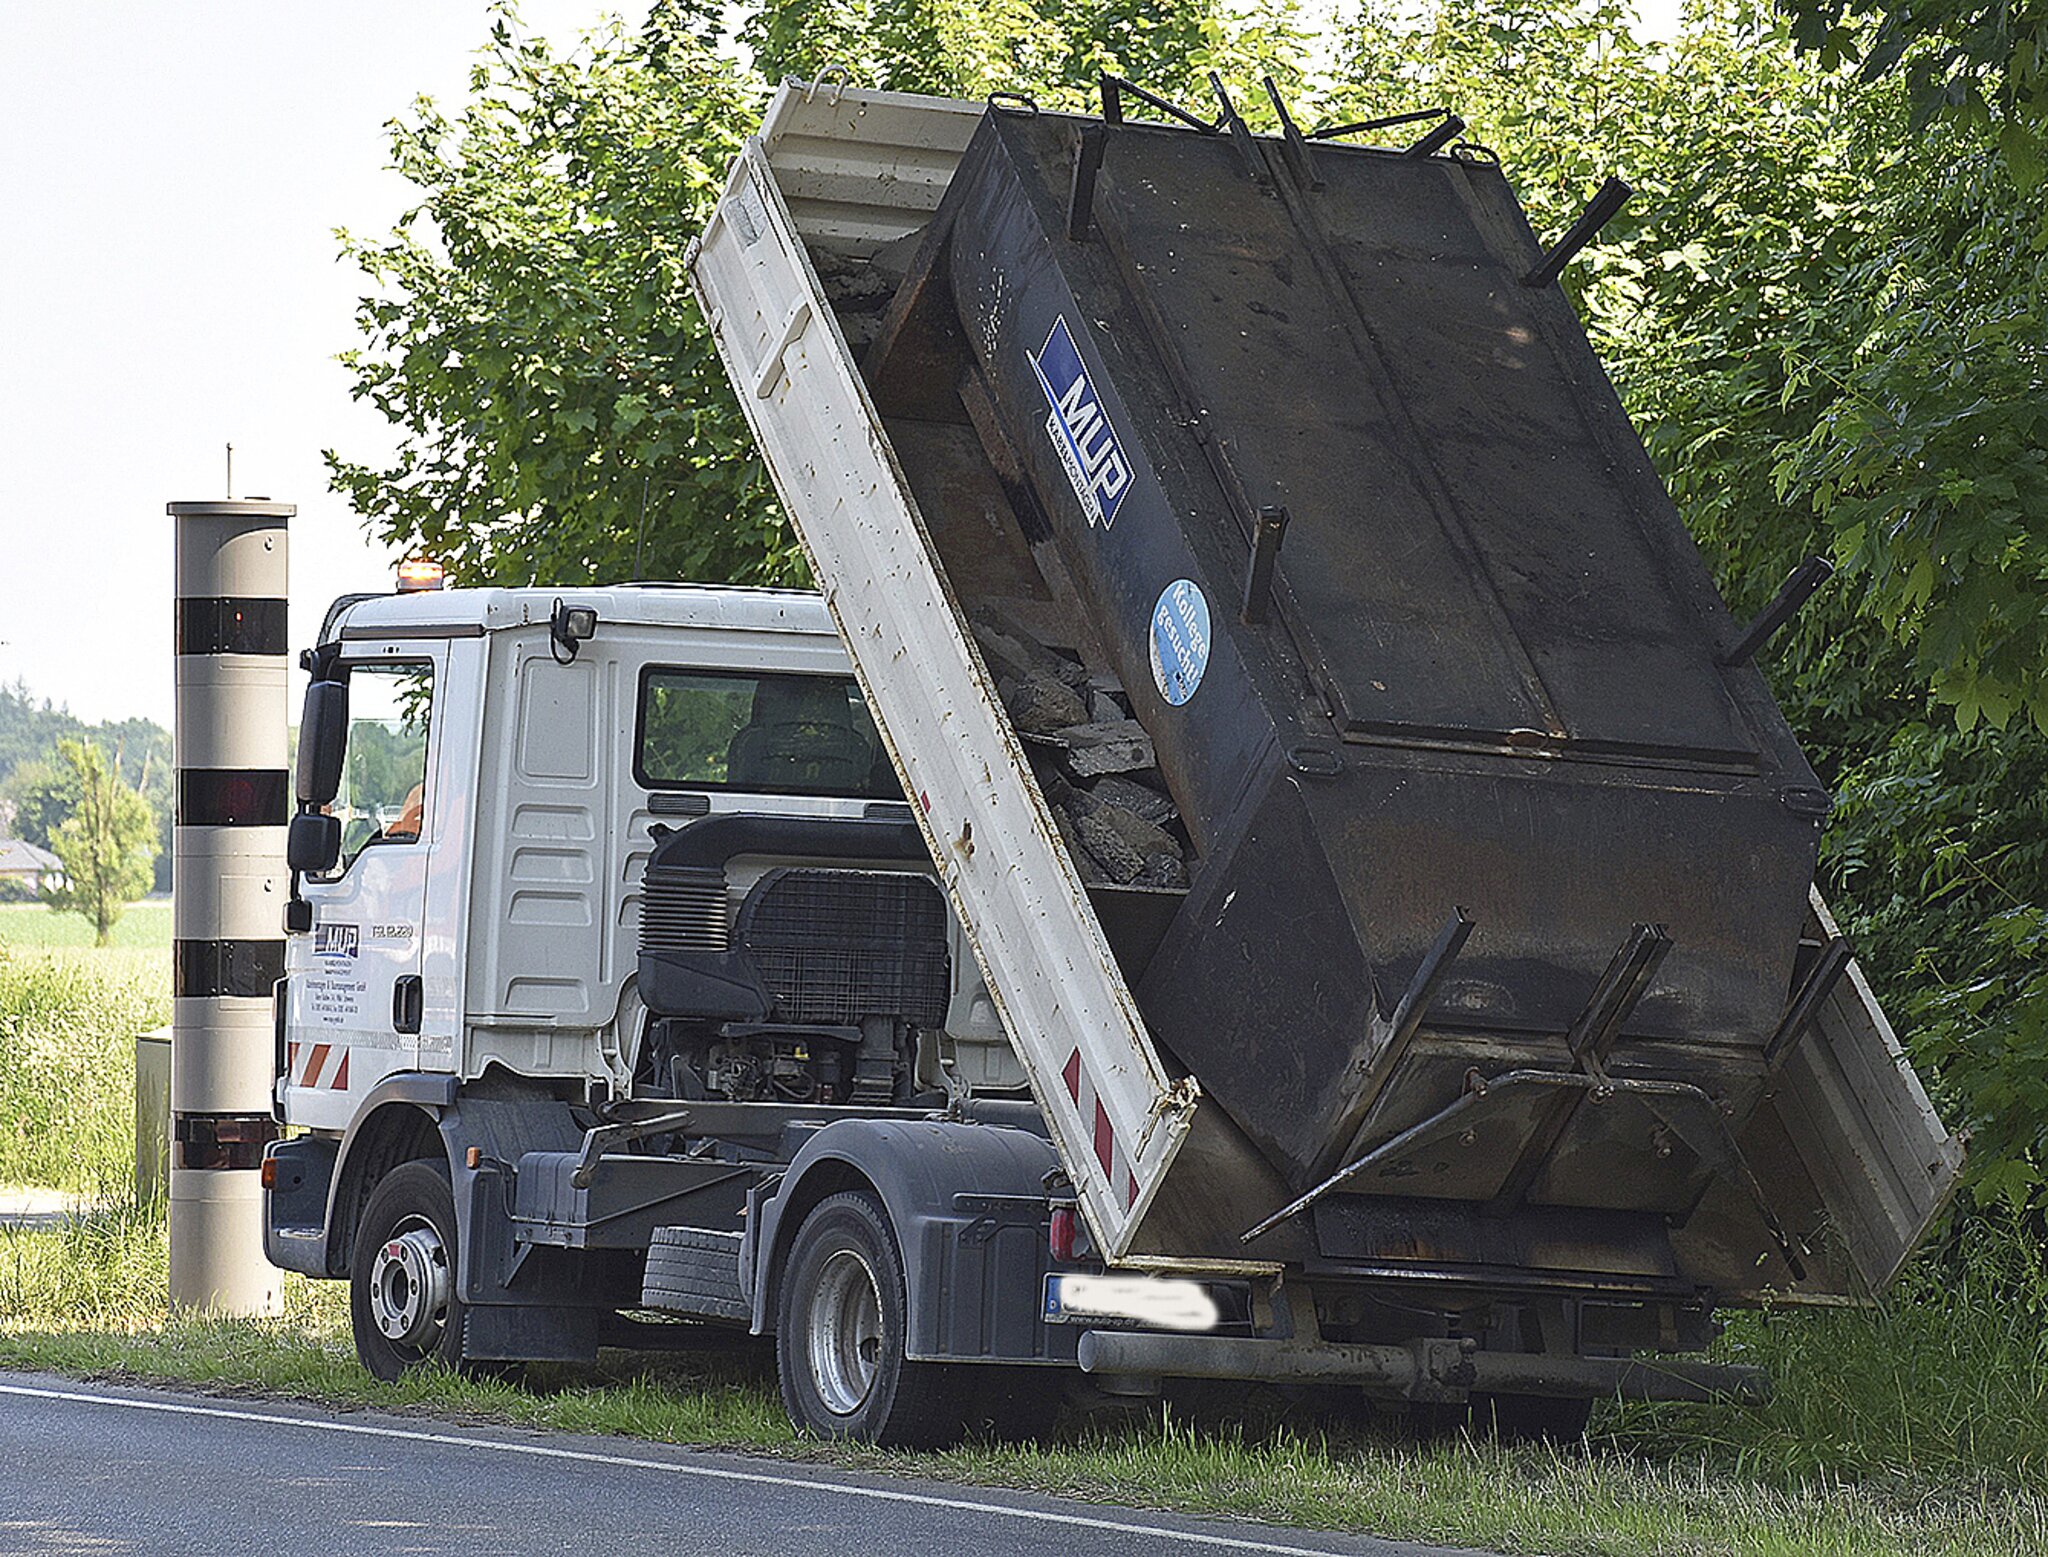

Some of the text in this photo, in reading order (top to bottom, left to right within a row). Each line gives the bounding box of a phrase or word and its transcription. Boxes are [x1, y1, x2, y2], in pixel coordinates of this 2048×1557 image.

[1057, 373, 1128, 500] MUP
[1157, 604, 1200, 687] gesucht!
[1172, 583, 1206, 659] Kollege
[323, 926, 358, 956] MUP
